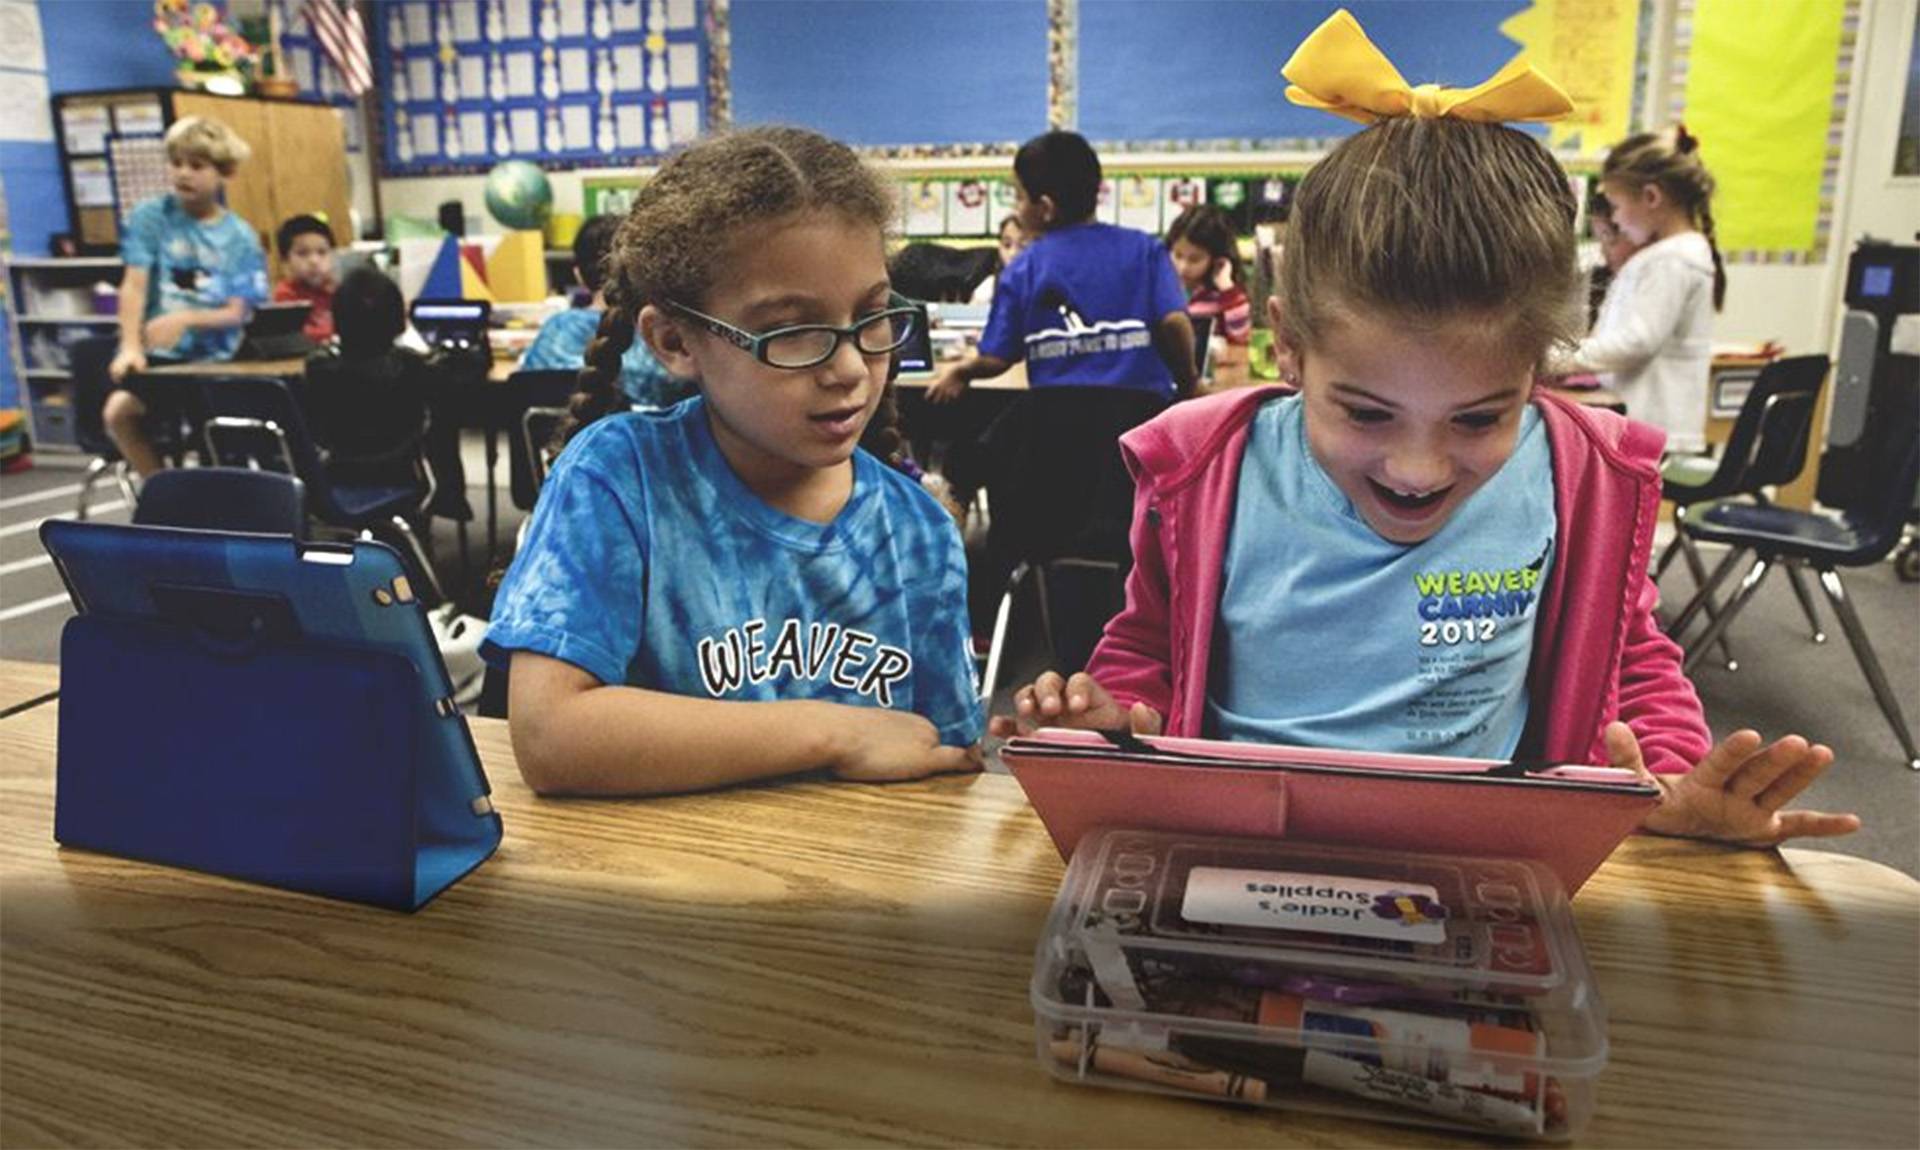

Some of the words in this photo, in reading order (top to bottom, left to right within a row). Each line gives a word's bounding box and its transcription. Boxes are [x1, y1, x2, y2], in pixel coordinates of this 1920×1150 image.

[1414, 569, 1540, 597] WEAVER
[1417, 591, 1536, 622] CARNIV
[1420, 619, 1497, 645] 2012
[697, 618, 912, 707] WEAVER
[1246, 882, 1370, 904] Supplies
[1258, 900, 1365, 920] Jadie's
